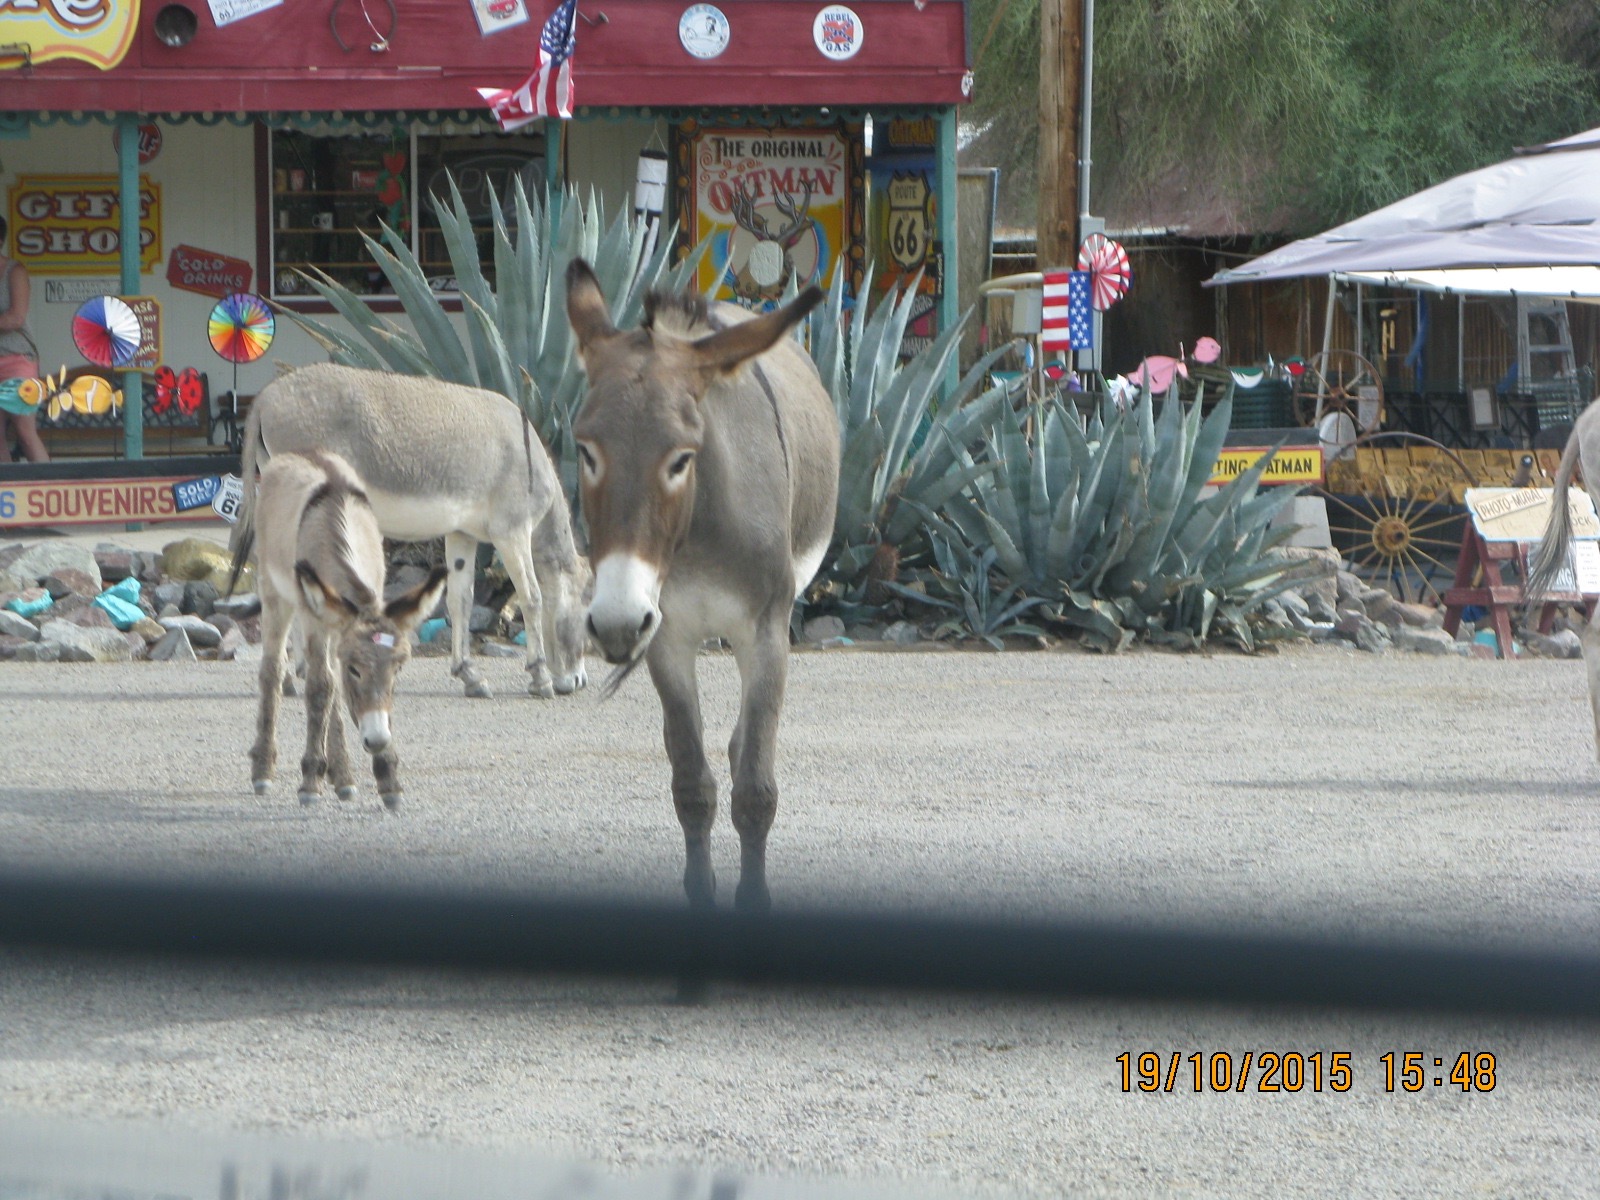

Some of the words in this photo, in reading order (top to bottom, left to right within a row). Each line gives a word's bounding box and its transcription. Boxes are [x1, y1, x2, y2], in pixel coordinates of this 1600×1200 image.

[824, 12, 850, 22] REBEL
[826, 42, 851, 52] GAS
[710, 136, 745, 165] THE
[751, 139, 826, 158] ORIGINAL
[708, 166, 838, 214] OATMAN
[895, 184, 917, 200] ROUTE
[894, 216, 918, 256] 66
[178, 258, 225, 272] COLD
[183, 271, 243, 288] DRINKS
[47, 281, 64, 301] NO
[1265, 458, 1313, 475] ATMAN
[178, 478, 213, 499] SOLD
[28, 487, 175, 518] SOUVENIRS
